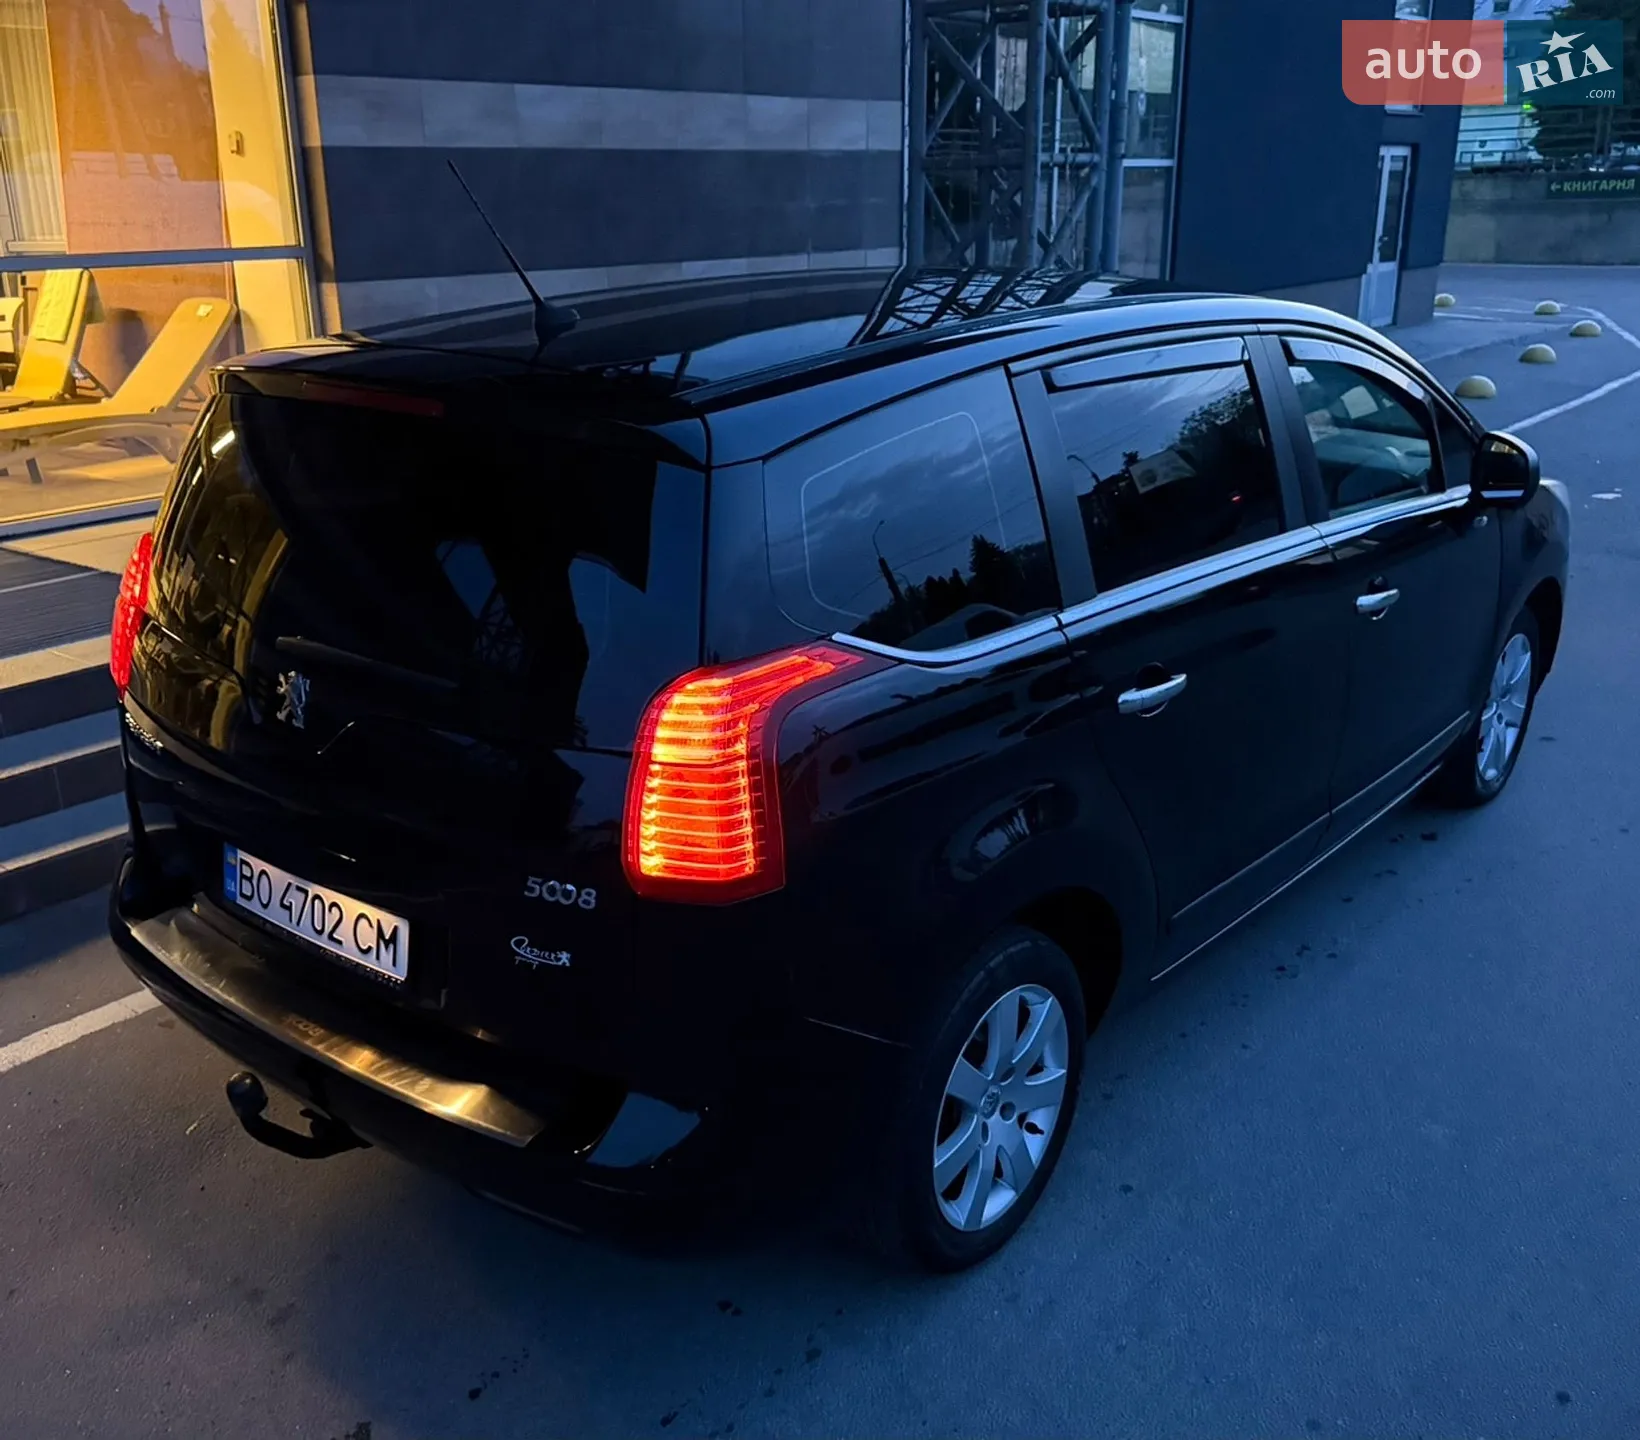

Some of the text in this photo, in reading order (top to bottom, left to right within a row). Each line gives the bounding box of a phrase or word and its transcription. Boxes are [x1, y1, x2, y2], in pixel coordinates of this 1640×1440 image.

[1563, 178, 1636, 193] КНИГАРНЯ
[523, 875, 597, 910] 5008
[239, 857, 273, 911] BO
[279, 881, 344, 946] 4702
[353, 912, 399, 968] CM
